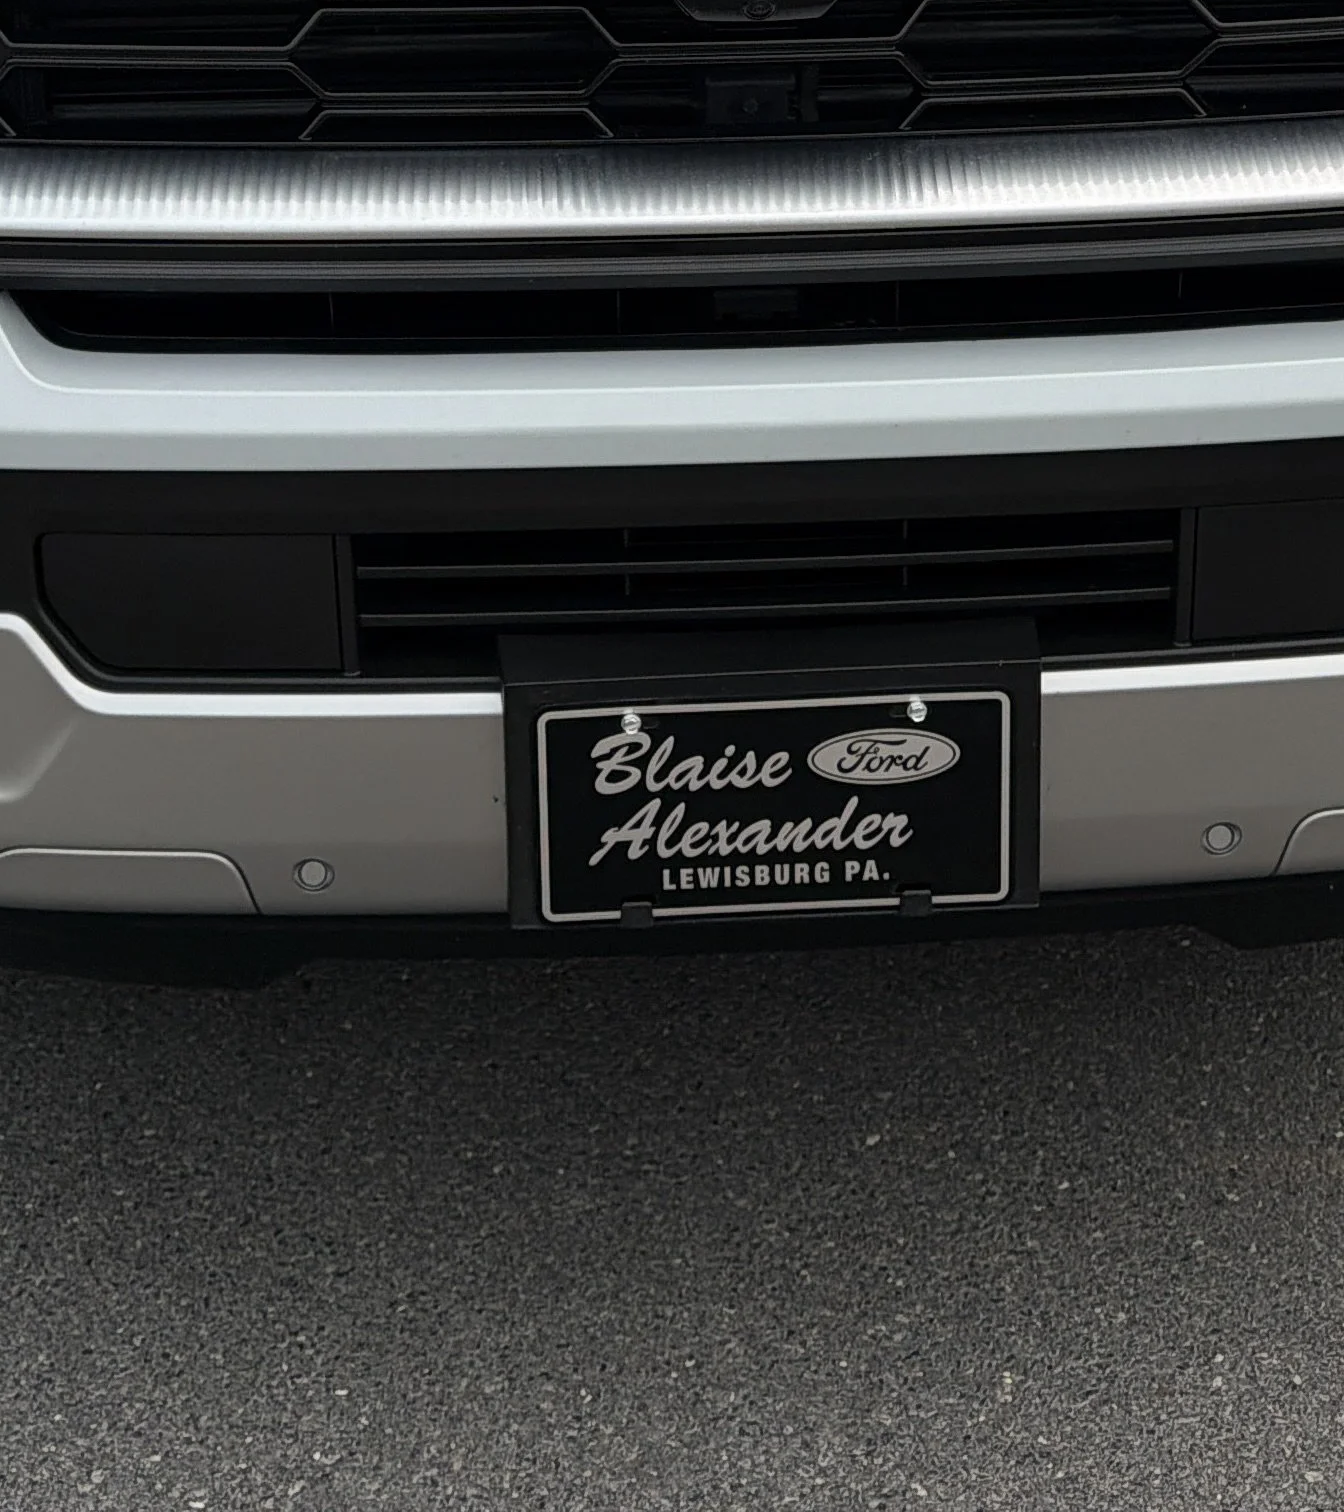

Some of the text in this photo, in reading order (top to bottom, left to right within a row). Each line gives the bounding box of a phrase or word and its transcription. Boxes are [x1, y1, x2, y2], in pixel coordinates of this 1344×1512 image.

[589, 731, 930, 796] Blaise Ford
[588, 795, 914, 867] Alexander
[662, 860, 891, 891] LEWISBURG PA.
